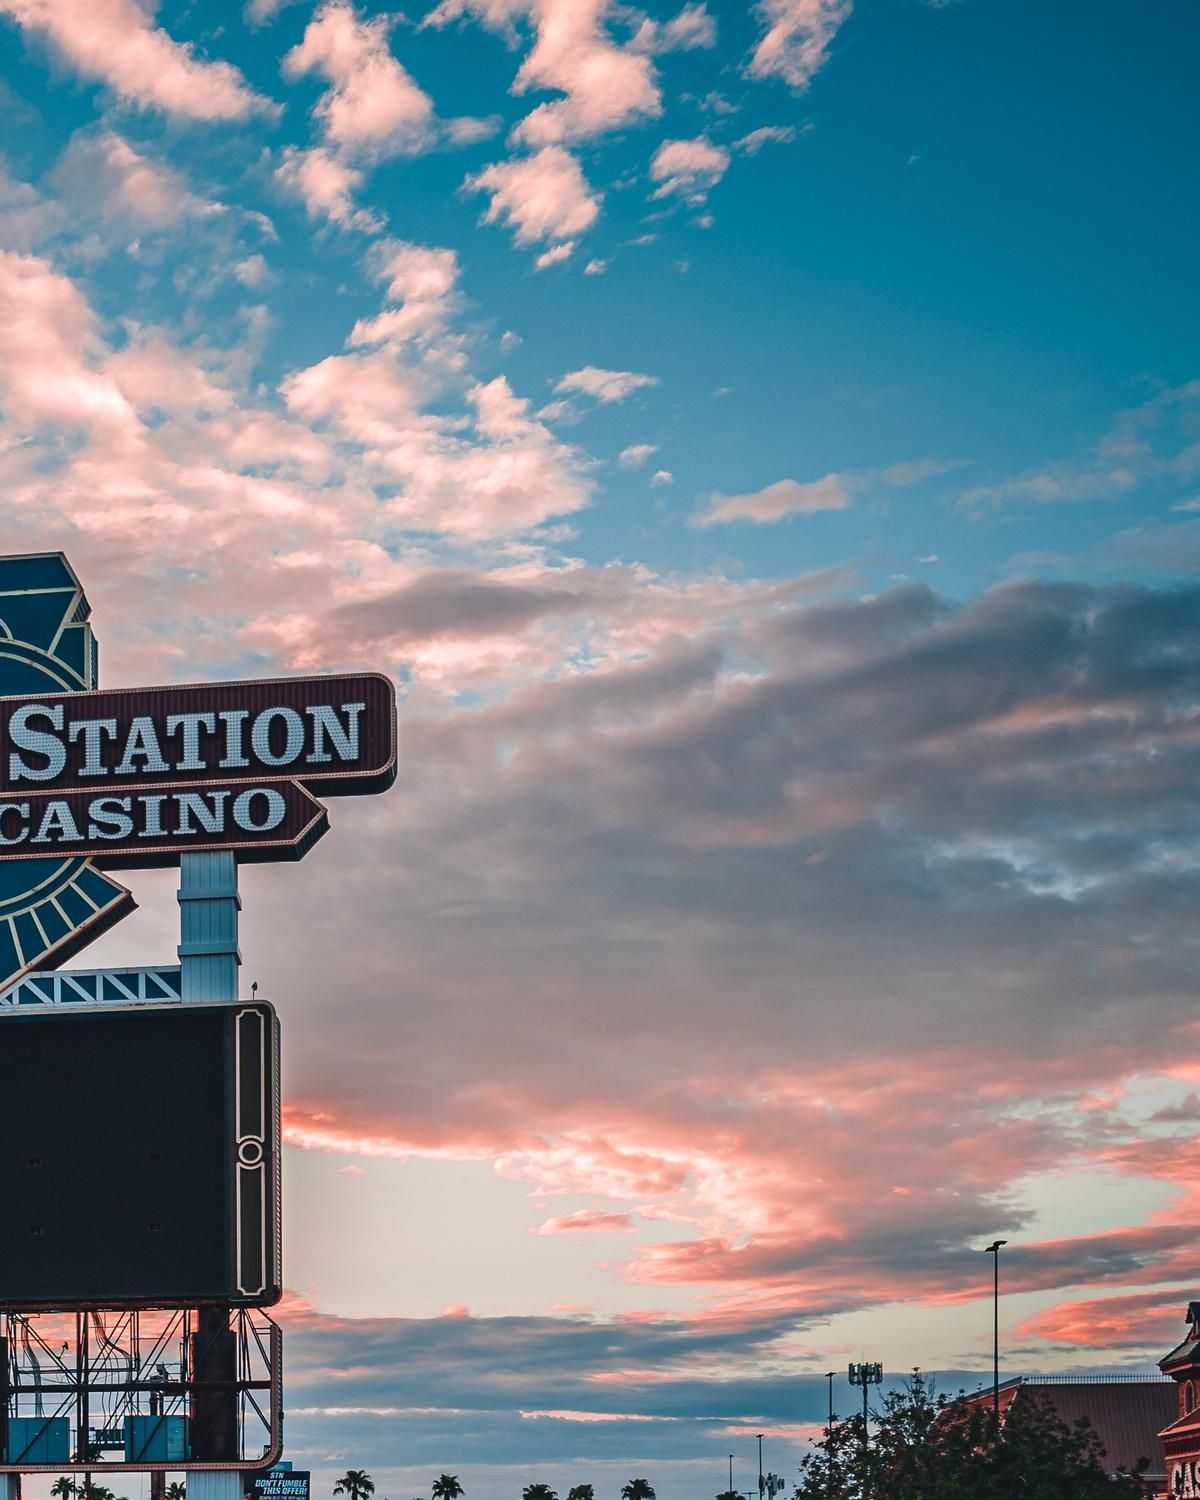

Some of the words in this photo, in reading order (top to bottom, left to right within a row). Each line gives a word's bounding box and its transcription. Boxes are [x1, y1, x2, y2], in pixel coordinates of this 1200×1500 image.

[8, 703, 366, 782] STATION
[255, 1479, 277, 1487] DON'T
[277, 1479, 308, 1487] FUMBLE
[263, 1487, 280, 1495] THIS
[282, 1487, 308, 1495] OFFER!
